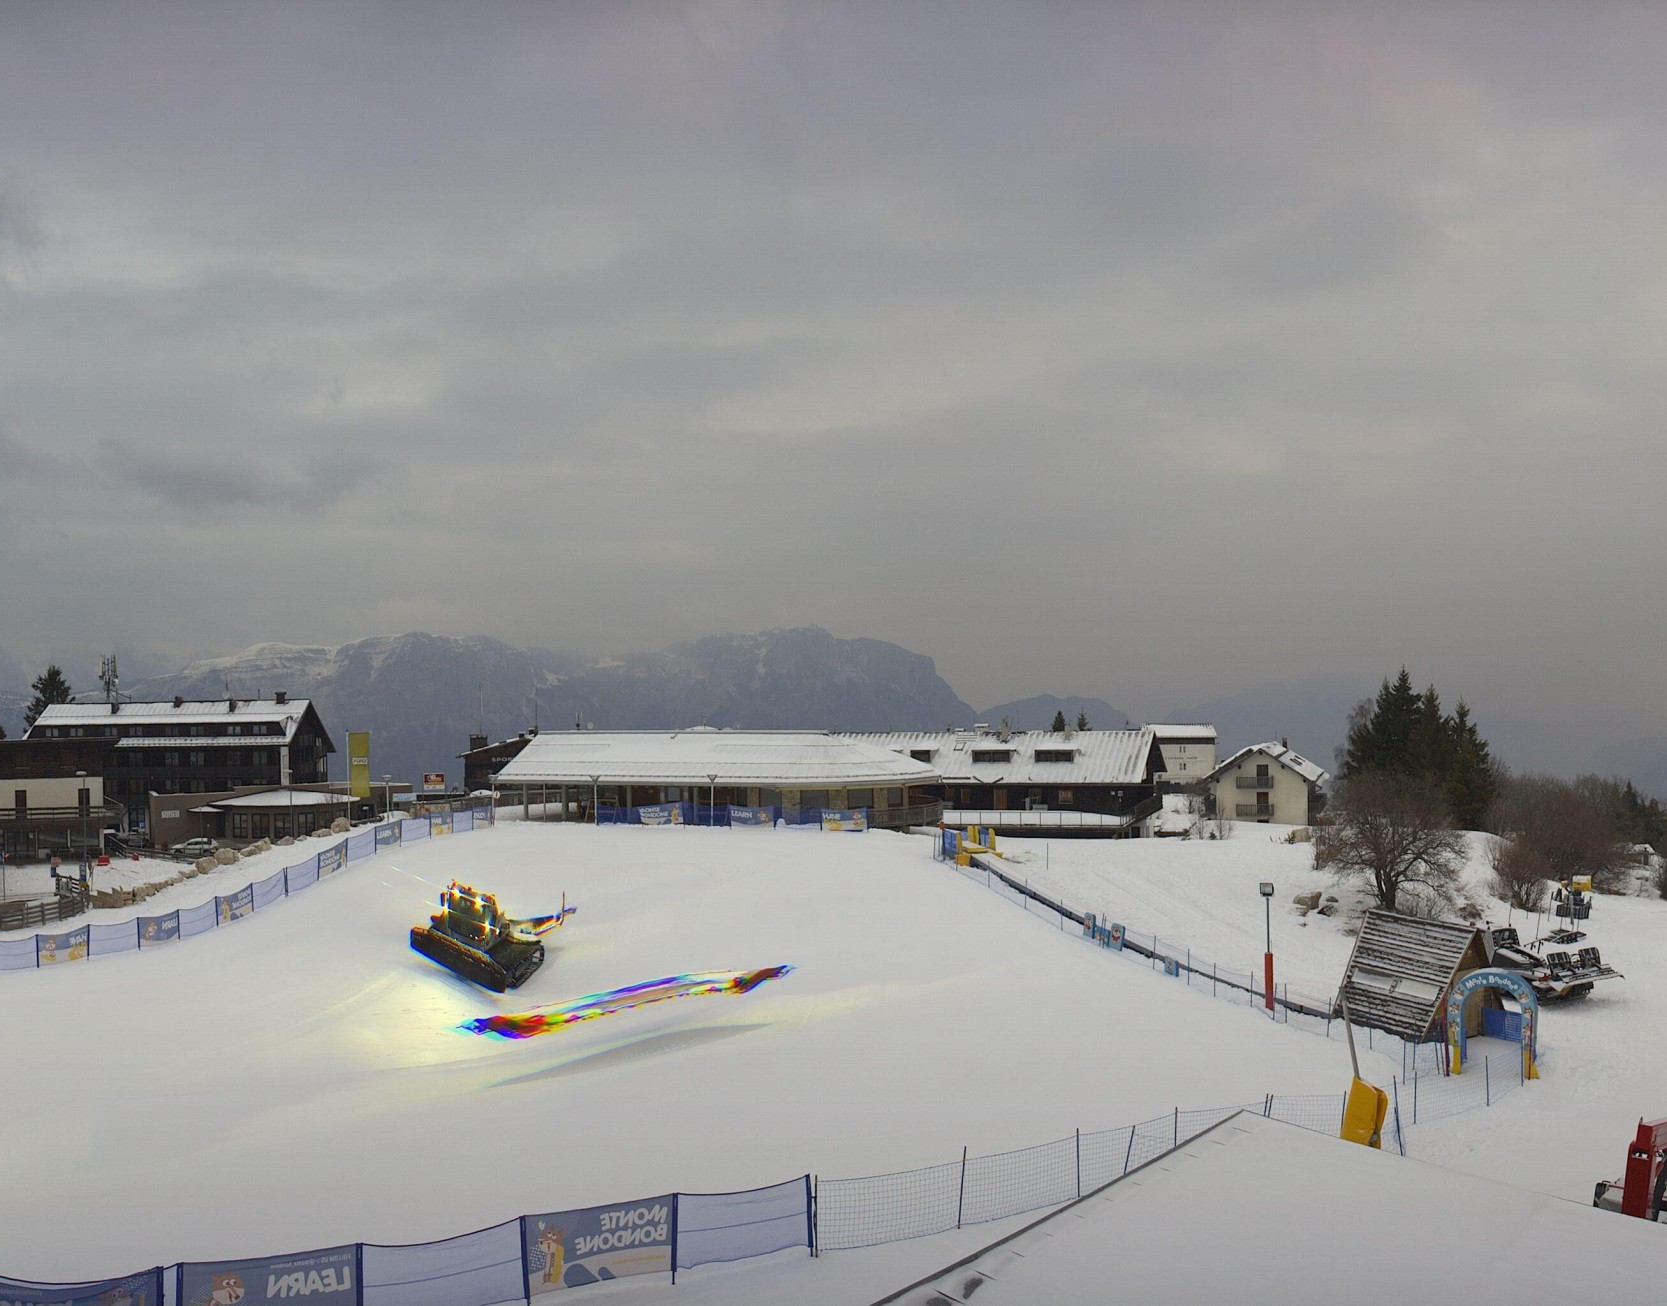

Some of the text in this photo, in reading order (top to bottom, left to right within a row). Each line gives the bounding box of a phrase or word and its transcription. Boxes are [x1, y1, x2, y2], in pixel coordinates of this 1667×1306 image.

[731, 809, 753, 818] LEARN
[377, 828, 392, 838] LEARN
[1464, 975, 1519, 990] Monte Bondone
